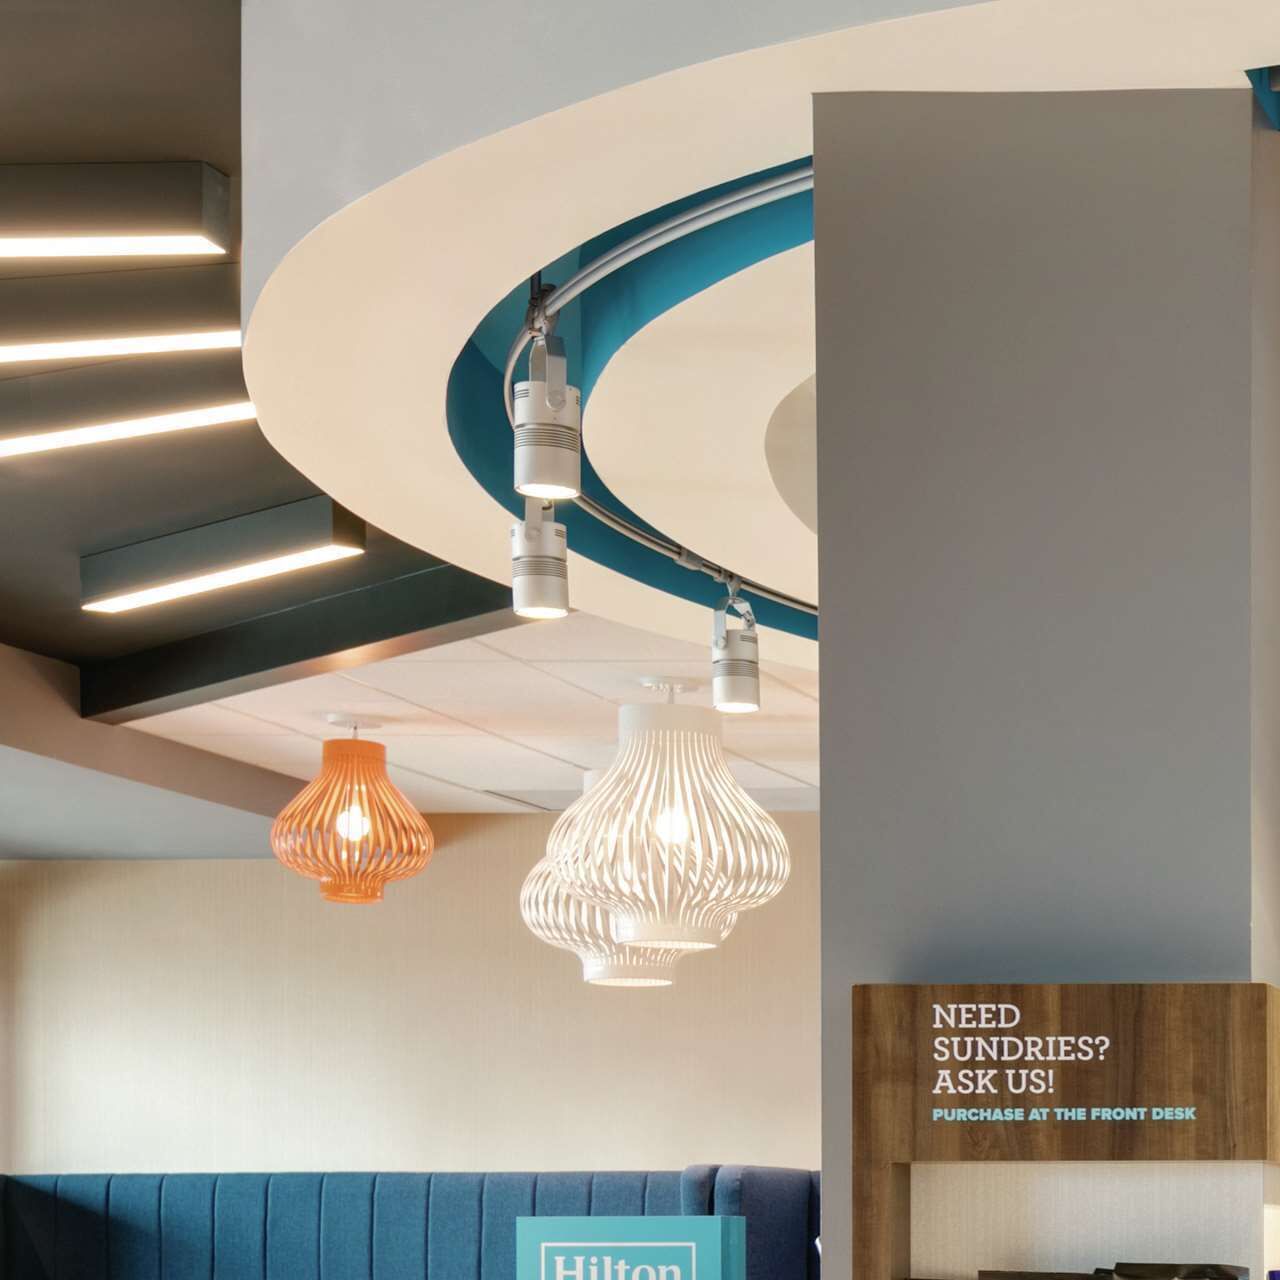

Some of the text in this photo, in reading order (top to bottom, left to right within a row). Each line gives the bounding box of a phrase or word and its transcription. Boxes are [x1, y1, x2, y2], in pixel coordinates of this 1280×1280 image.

[932, 1003, 1020, 1029] NEED
[932, 1036, 1110, 1062] SUNDRIES?
[932, 1068, 1054, 1094] ASK US!
[932, 1106, 1197, 1121] PURCHASE AT THE FRONT DESK
